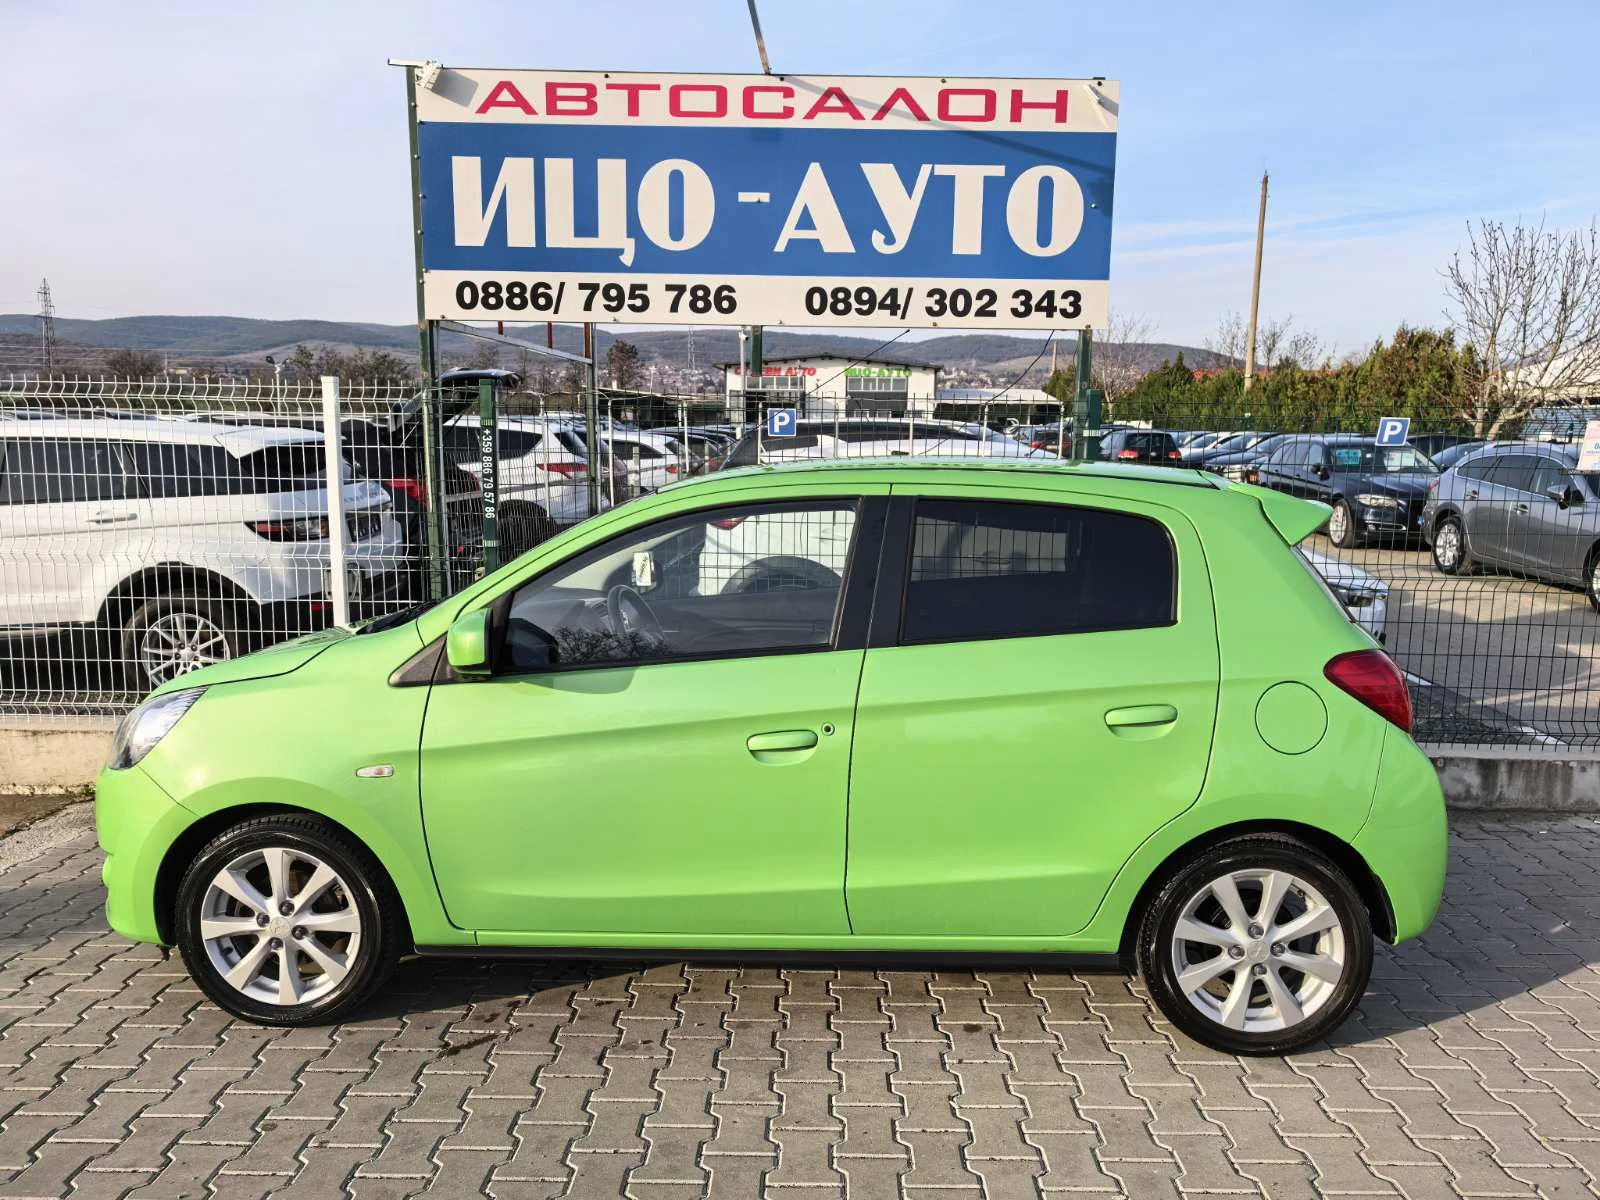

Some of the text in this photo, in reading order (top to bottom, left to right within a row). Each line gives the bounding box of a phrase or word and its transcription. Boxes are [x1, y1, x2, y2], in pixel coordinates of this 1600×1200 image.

[475, 79, 1070, 127] АВТОСАЛОН
[455, 280, 1082, 320] 0886/ 795 786 0894/ 302 343
[773, 411, 790, 433] P
[1382, 421, 1403, 442] P
[482, 428, 496, 519] +359 886 79 57 86
